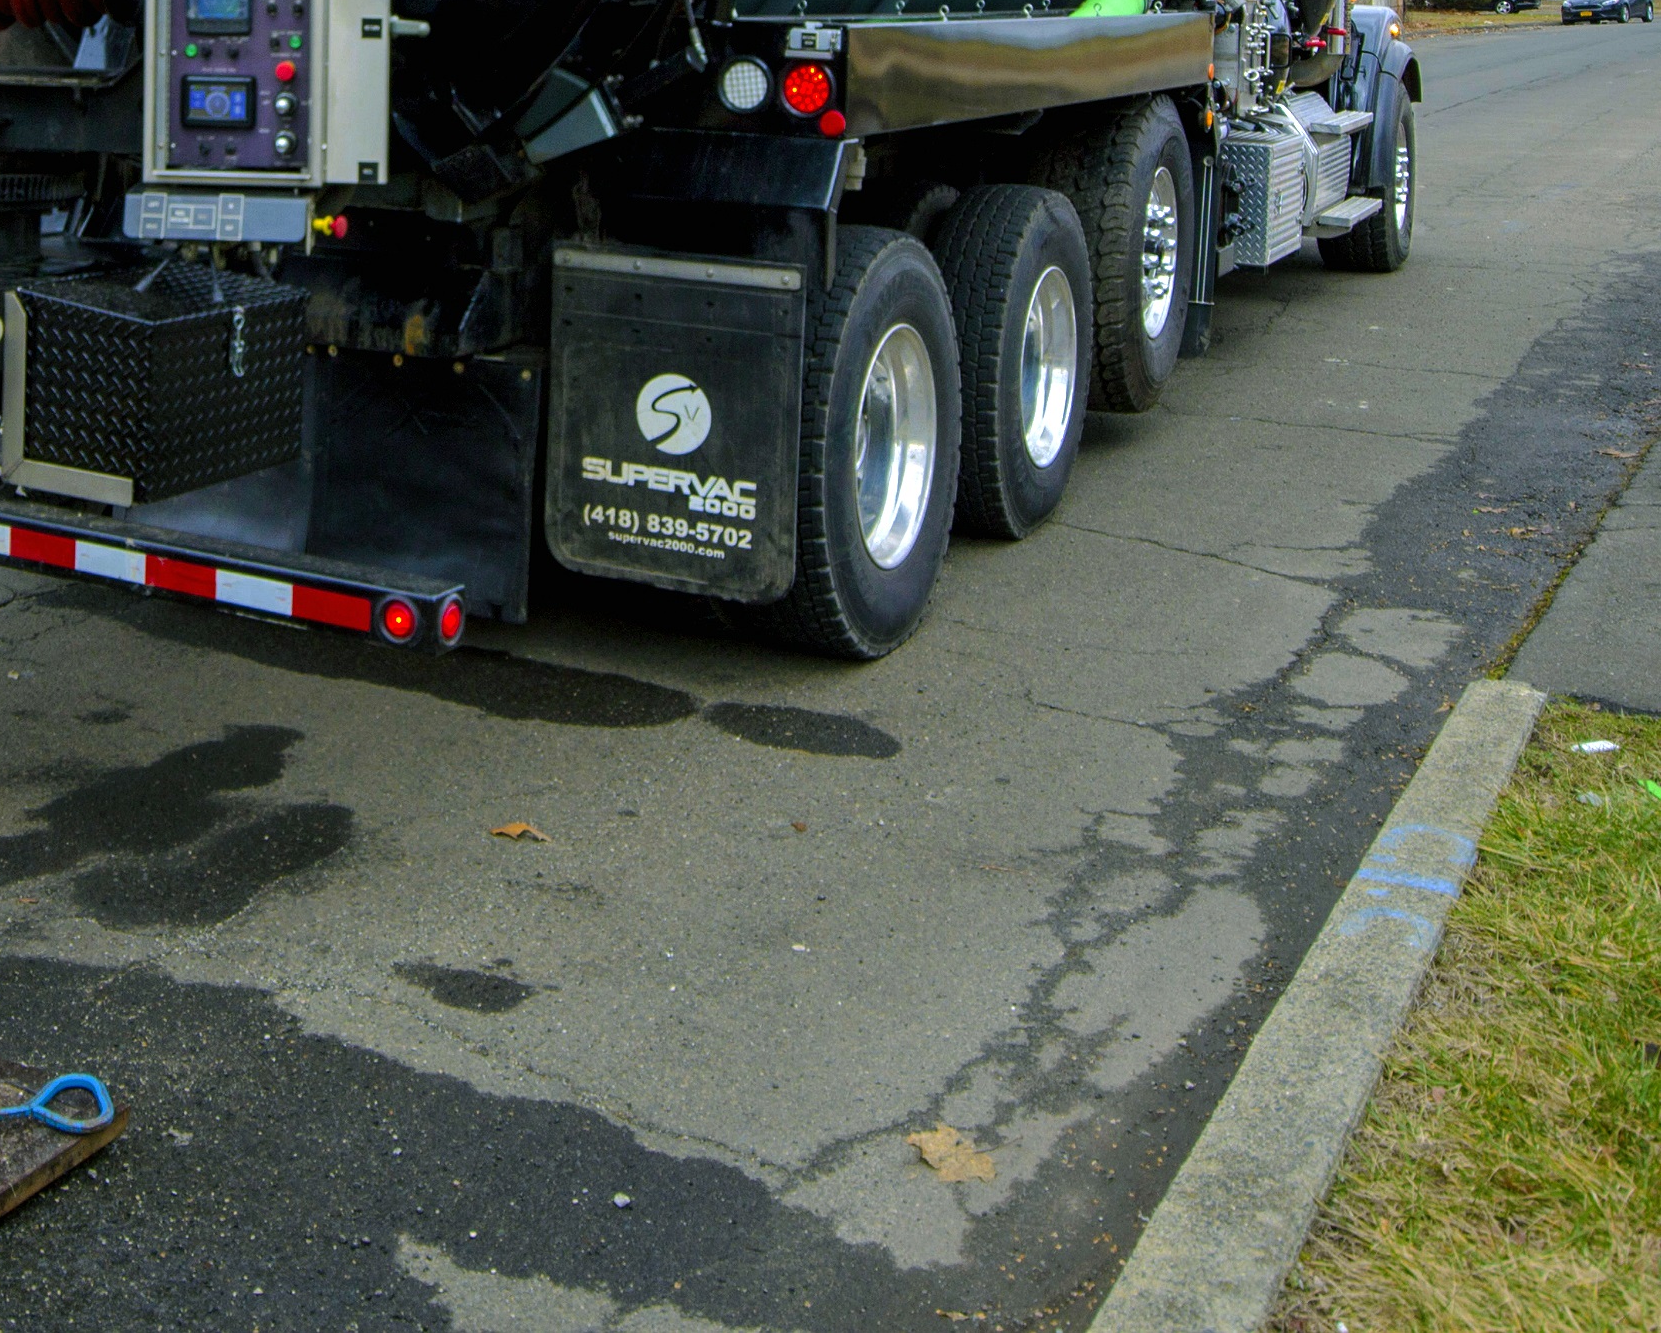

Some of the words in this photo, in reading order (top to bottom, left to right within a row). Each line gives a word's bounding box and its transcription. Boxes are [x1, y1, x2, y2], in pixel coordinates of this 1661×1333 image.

[581, 456, 757, 507] SUPERVAC
[583, 503, 640, 534] (418)
[646, 513, 753, 550] 839-5702
[688, 495, 757, 521] 2000
[608, 530, 726, 560] supervac2000.com
